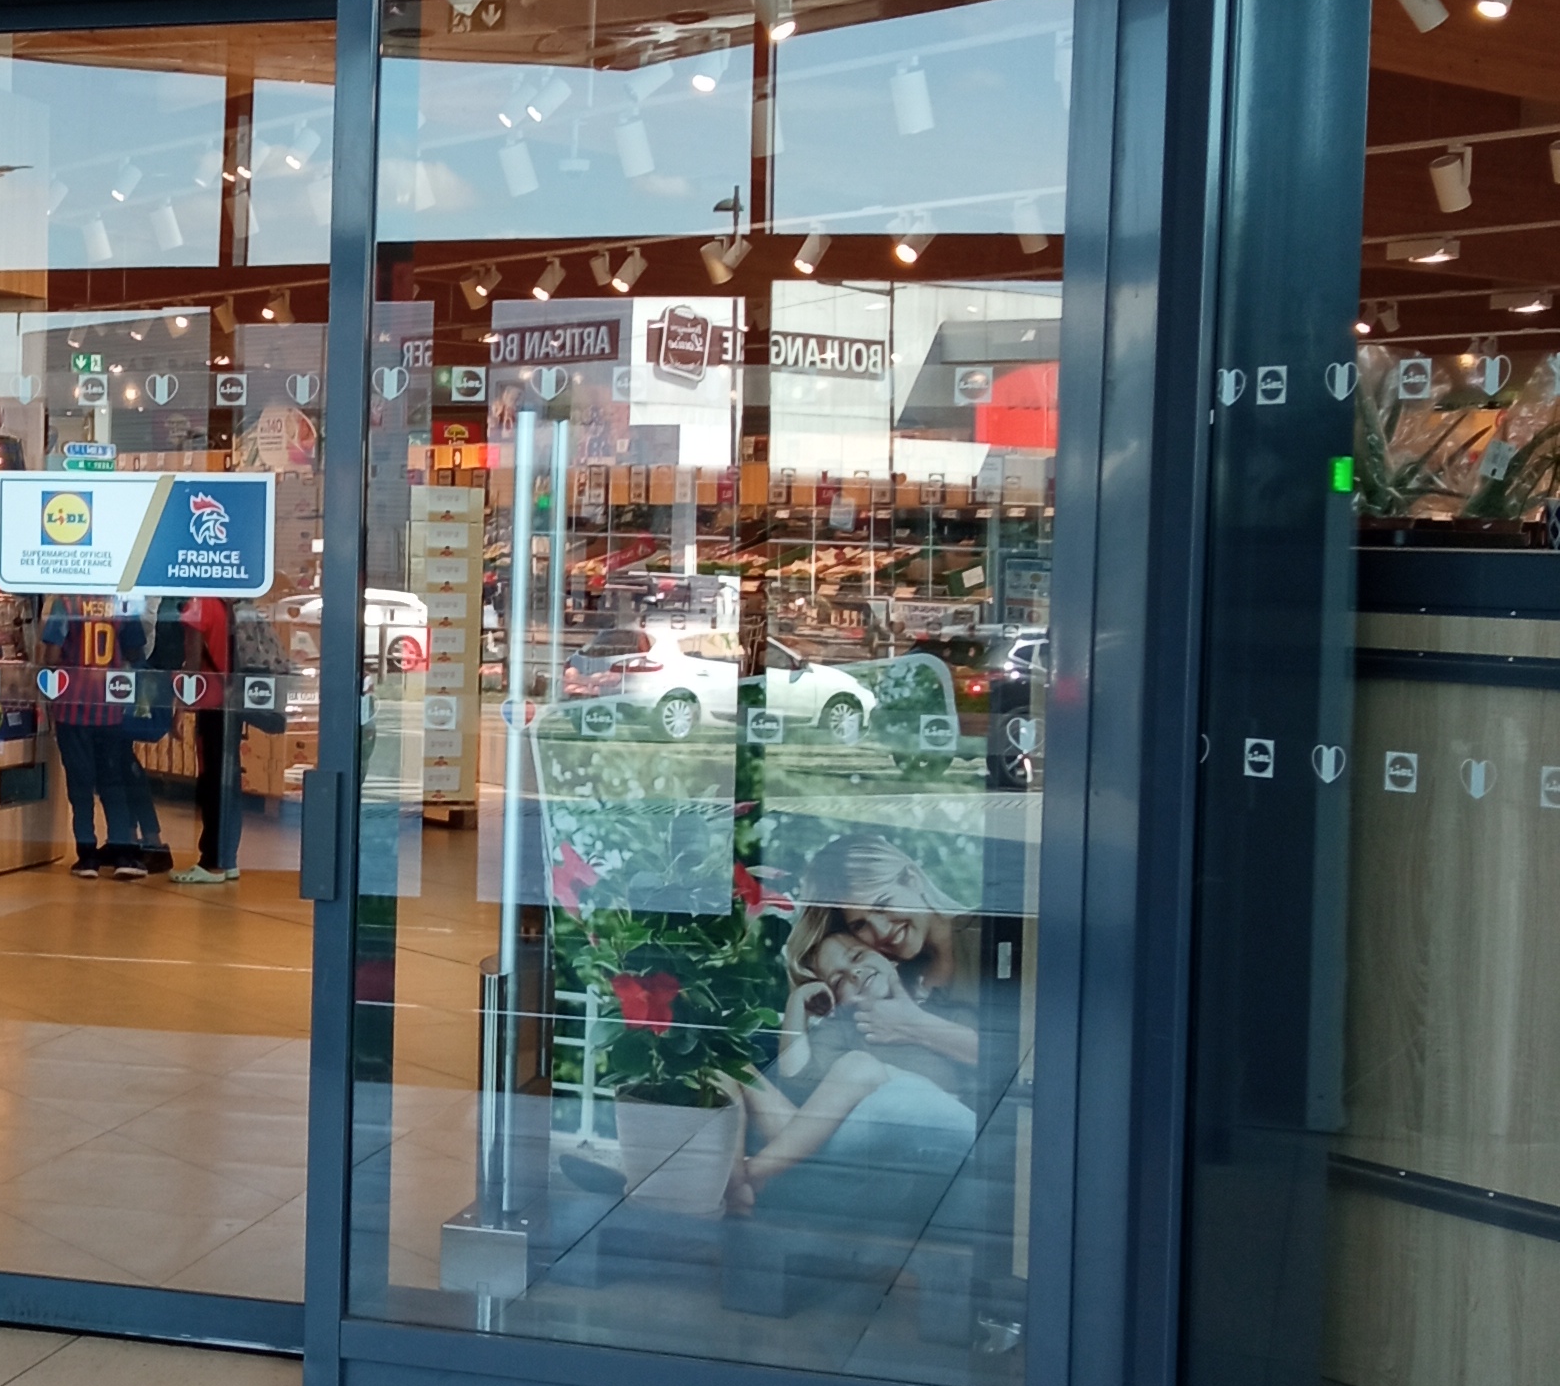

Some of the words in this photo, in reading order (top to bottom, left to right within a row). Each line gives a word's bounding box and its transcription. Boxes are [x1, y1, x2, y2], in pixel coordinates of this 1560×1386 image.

[22, 549, 78, 559] SUPERMARCHÉ
[80, 551, 112, 559] OFFICIEL
[20, 558, 35, 566] DES
[71, 559, 81, 567] DE
[83, 559, 112, 567] FRANCE
[40, 567, 50, 575] DE
[52, 567, 91, 575] HANDBALL
[84, 621, 115, 666] 10
